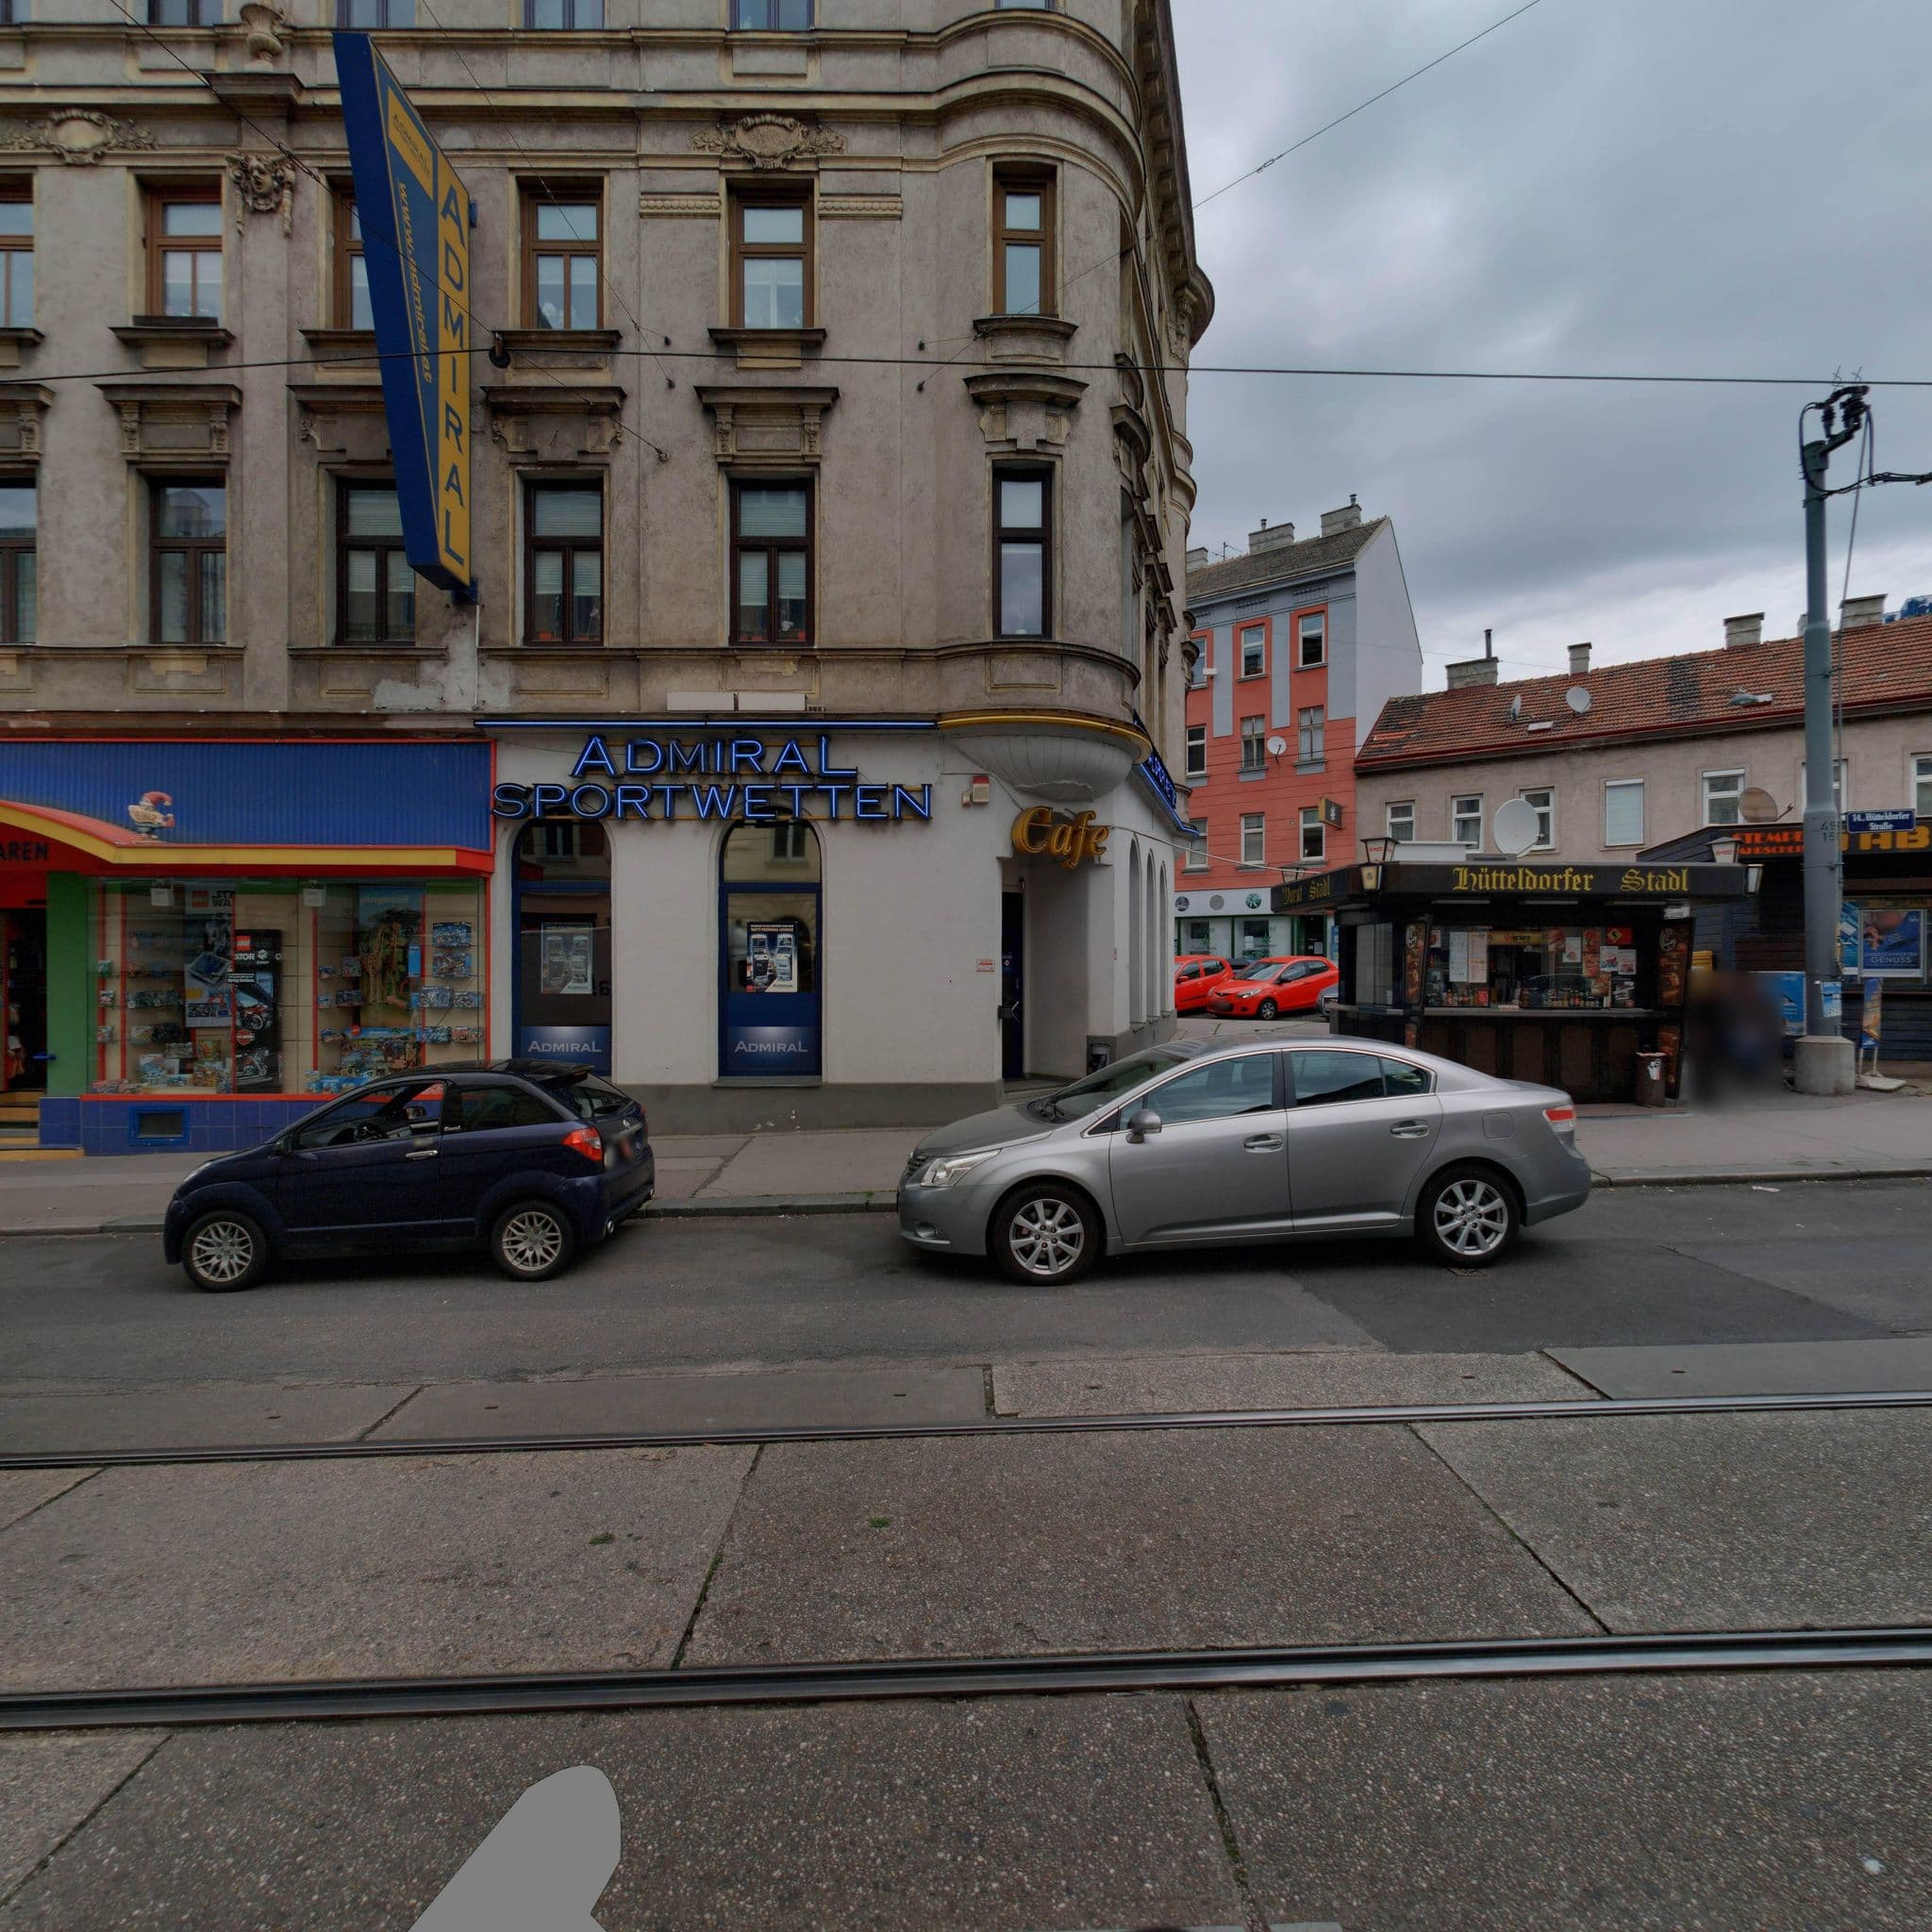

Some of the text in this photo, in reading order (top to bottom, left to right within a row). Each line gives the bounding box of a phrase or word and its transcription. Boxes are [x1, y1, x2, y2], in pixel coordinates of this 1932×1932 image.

[441, 182, 468, 568] ADMIRAL
[570, 734, 858, 778] ADMIRAL
[491, 783, 933, 822] SPORTWETTEN
[1011, 806, 1110, 870] Cafe
[1869, 822, 1894, 830] Straße
[1308, 875, 1330, 900] Stadl
[1452, 866, 1689, 892] Hütteldorfer Stadl
[527, 1040, 602, 1054] ADMIRAL
[734, 1040, 808, 1054] ADMIRAL
